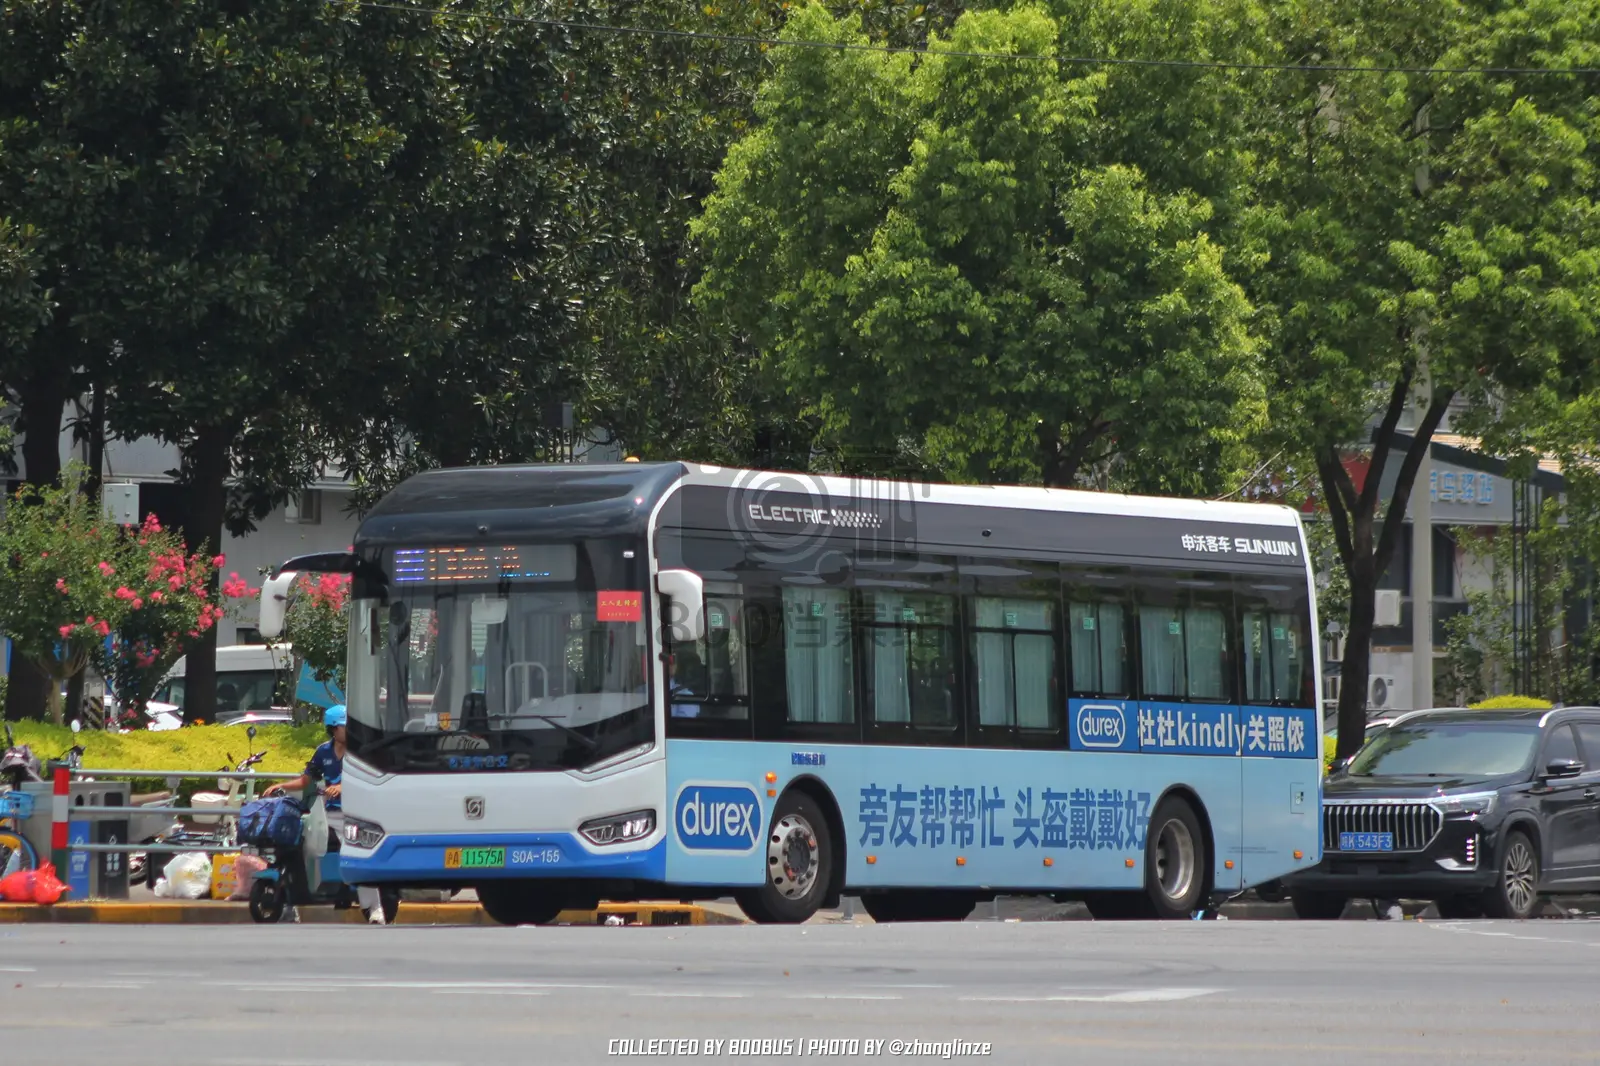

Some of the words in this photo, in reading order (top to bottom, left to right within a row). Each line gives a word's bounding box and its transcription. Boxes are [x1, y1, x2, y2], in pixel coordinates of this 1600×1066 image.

[749, 504, 831, 526] ELECTRIC
[1181, 534, 1232, 554] 申沃客车
[1234, 537, 1298, 558] SUNWIN
[1082, 711, 1123, 741] durex
[682, 790, 757, 848] durex
[858, 783, 1006, 849] 旁友帮帮忙
[1012, 786, 1152, 851] 头盔戴戴好
